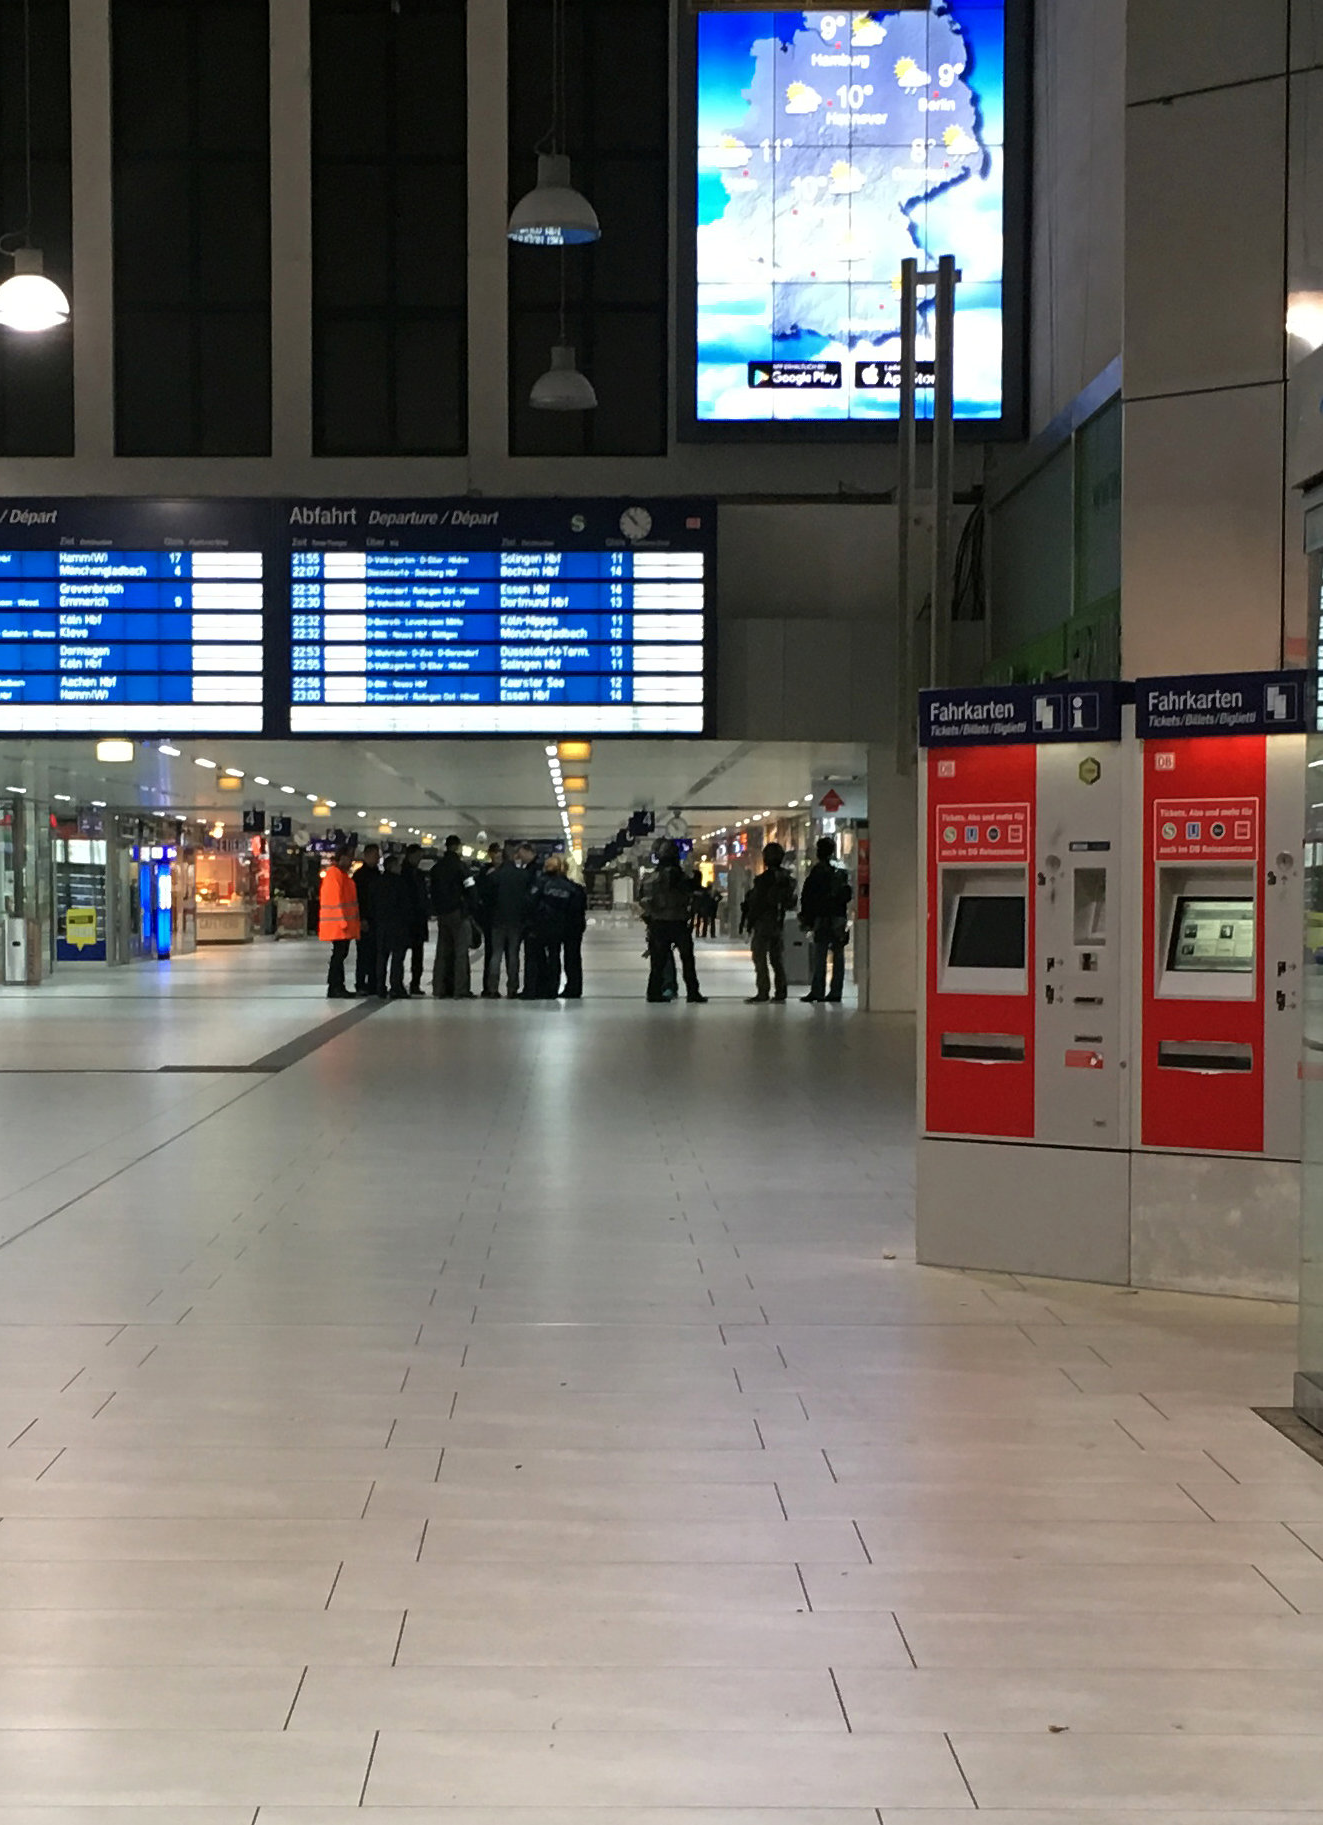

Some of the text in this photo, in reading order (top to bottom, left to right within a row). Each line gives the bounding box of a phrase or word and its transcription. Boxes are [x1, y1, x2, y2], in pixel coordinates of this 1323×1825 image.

[811, 54, 870, 69] Hamburg
[918, 98, 956, 112] Berlin
[826, 112, 888, 126] Hannover
[772, 371, 838, 387] Google Play
[9, 509, 57, 526] Départ
[289, 507, 356, 525] Abfahrt
[368, 510, 437, 527] Departure
[451, 510, 499, 527] Départ
[501, 553, 542, 566] Solingen
[544, 553, 561, 564] Hbf
[292, 566, 320, 577] 22:07
[500, 565, 539, 577] Bochum
[542, 566, 559, 577] Hbf
[292, 584, 320, 595] 22:30
[500, 584, 530, 595] Essen
[533, 584, 550, 595] Hbf
[501, 597, 549, 608] Dortmund
[551, 597, 569, 608] Hbf
[85, 614, 102, 625] Hbf
[293, 615, 320, 627] 22:32
[293, 628, 320, 639] 22:32
[85, 658, 102, 668] Hbf
[544, 659, 561, 669] Hbf
[99, 676, 116, 687] Hbf
[293, 690, 321, 701] 23:00
[500, 689, 530, 701] Essen
[533, 689, 550, 701] Hbf
[1148, 689, 1242, 712] Fahrkarten
[930, 701, 1014, 721] Fahrkarten
